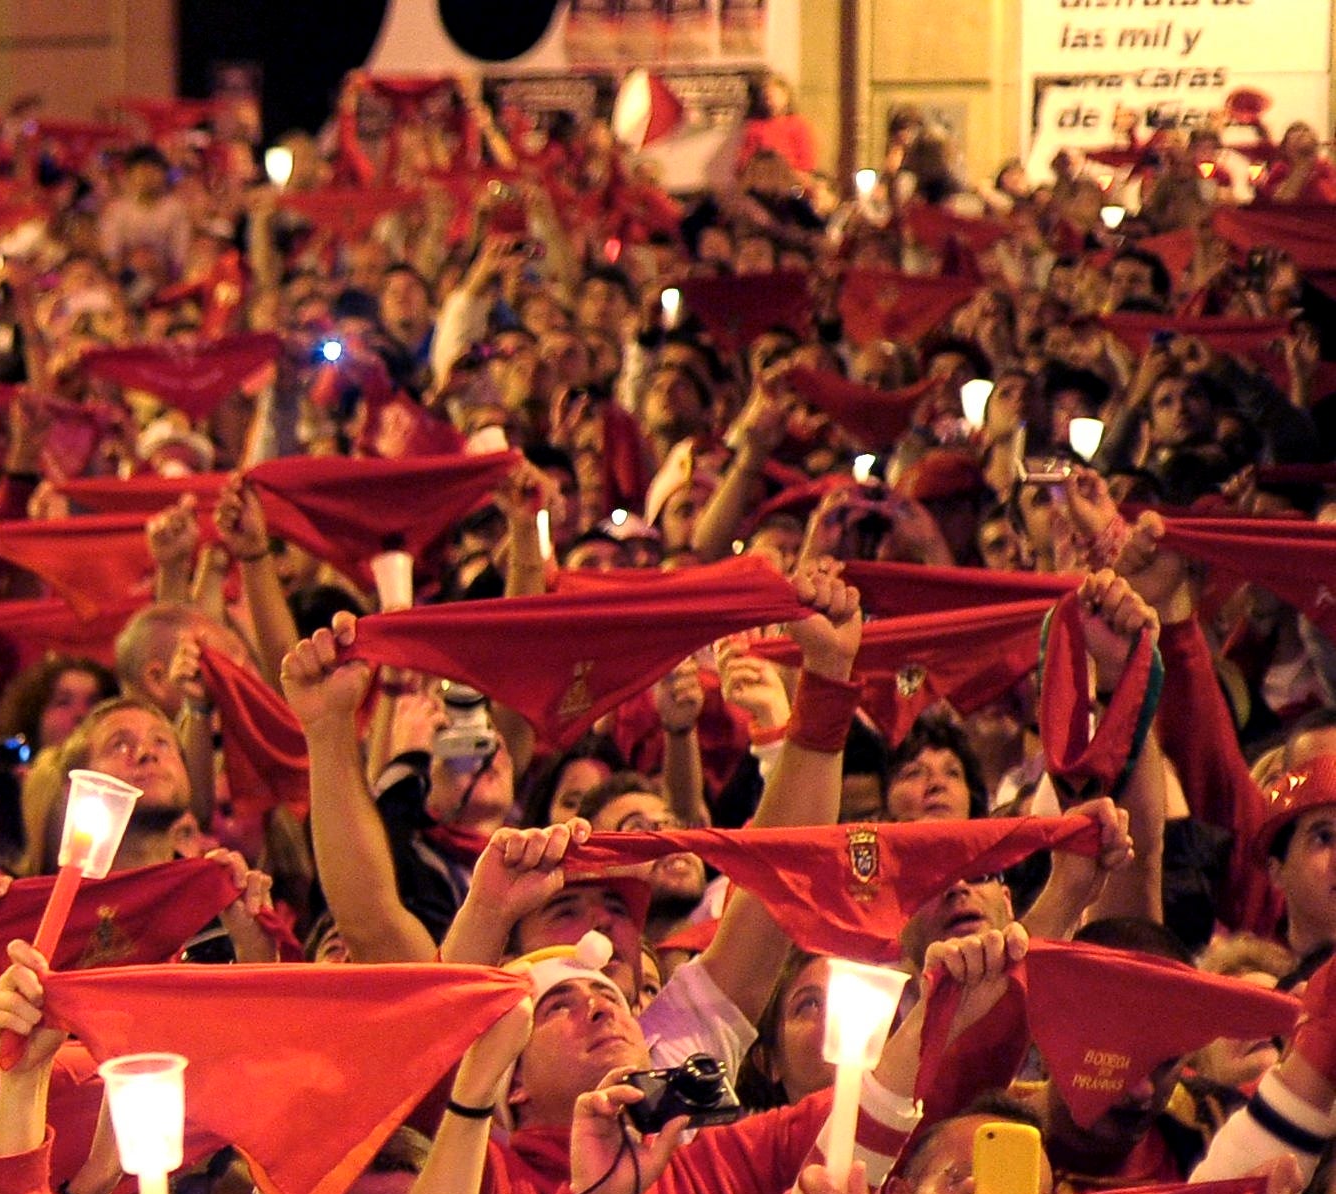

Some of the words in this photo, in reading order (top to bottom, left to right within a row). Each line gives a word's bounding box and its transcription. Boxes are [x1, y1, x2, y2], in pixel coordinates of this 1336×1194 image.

[1061, 22, 1105, 48] las
[1117, 20, 1173, 48] mil
[1181, 28, 1202, 56] y
[1058, 101, 1101, 129] de
